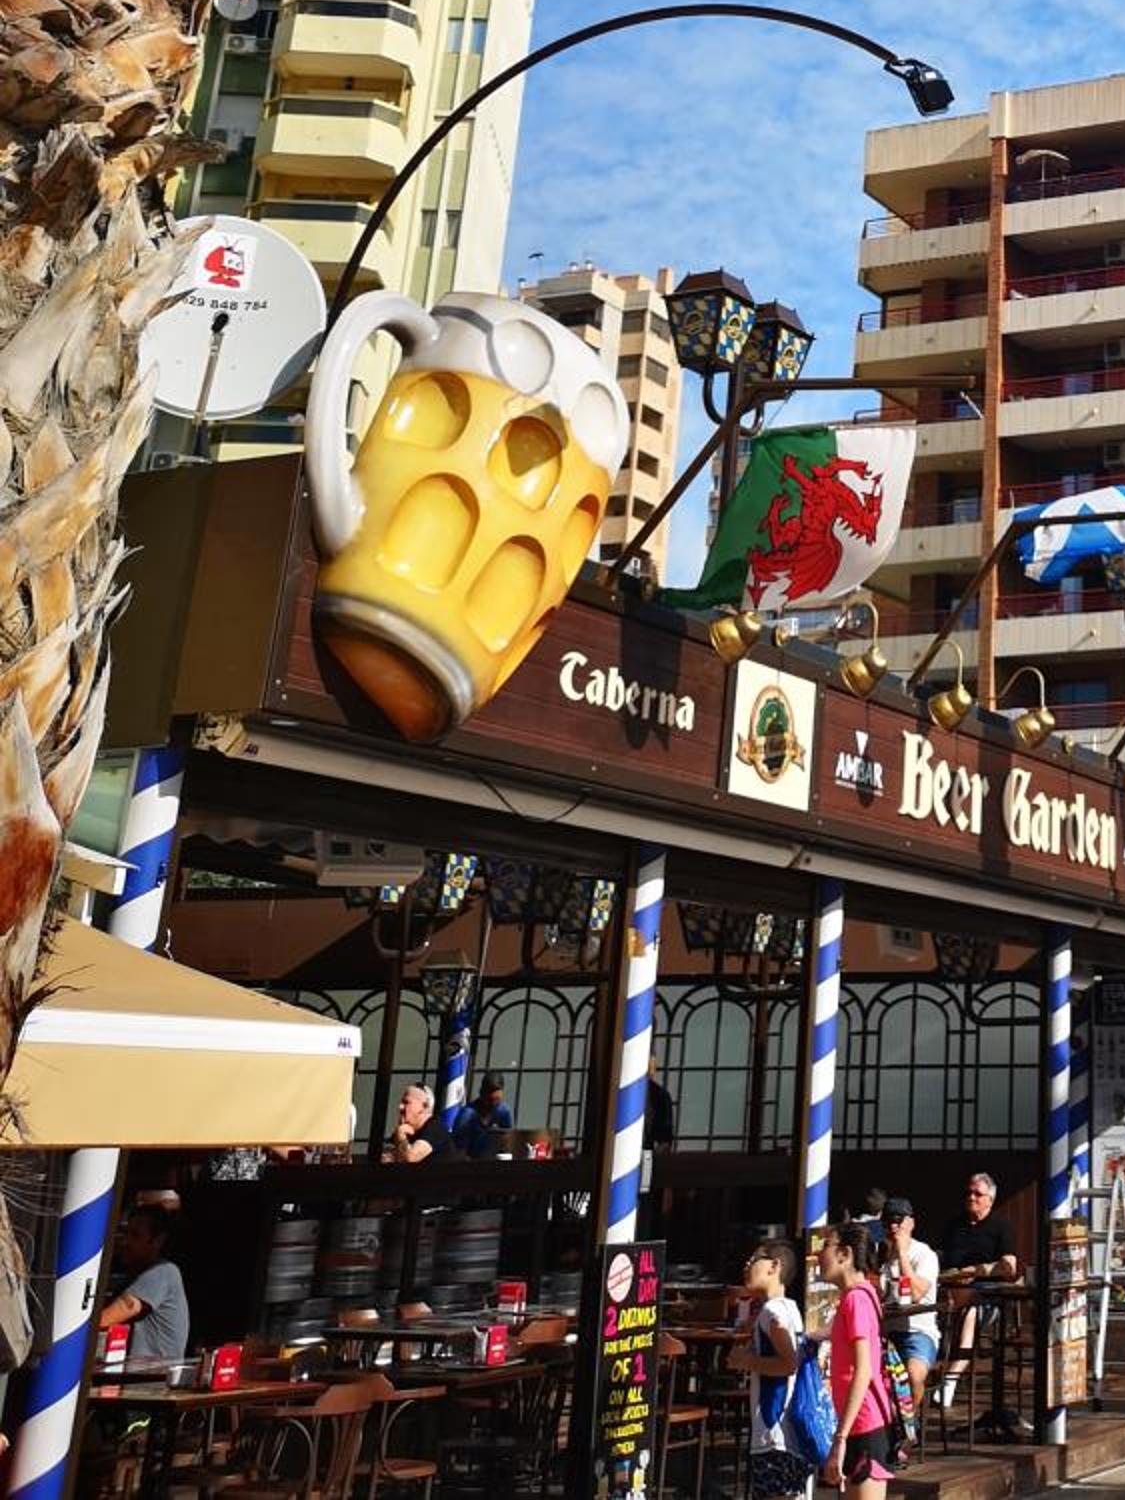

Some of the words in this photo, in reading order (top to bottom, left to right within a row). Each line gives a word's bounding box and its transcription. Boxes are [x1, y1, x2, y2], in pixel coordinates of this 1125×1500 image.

[835, 751, 883, 789] AMBAR
[900, 729, 990, 836] Beer
[1003, 767, 1117, 872] Garden
[604, 1306, 618, 1337] 2
[612, 1358, 632, 1382] OF
[633, 1353, 647, 1381] 1
